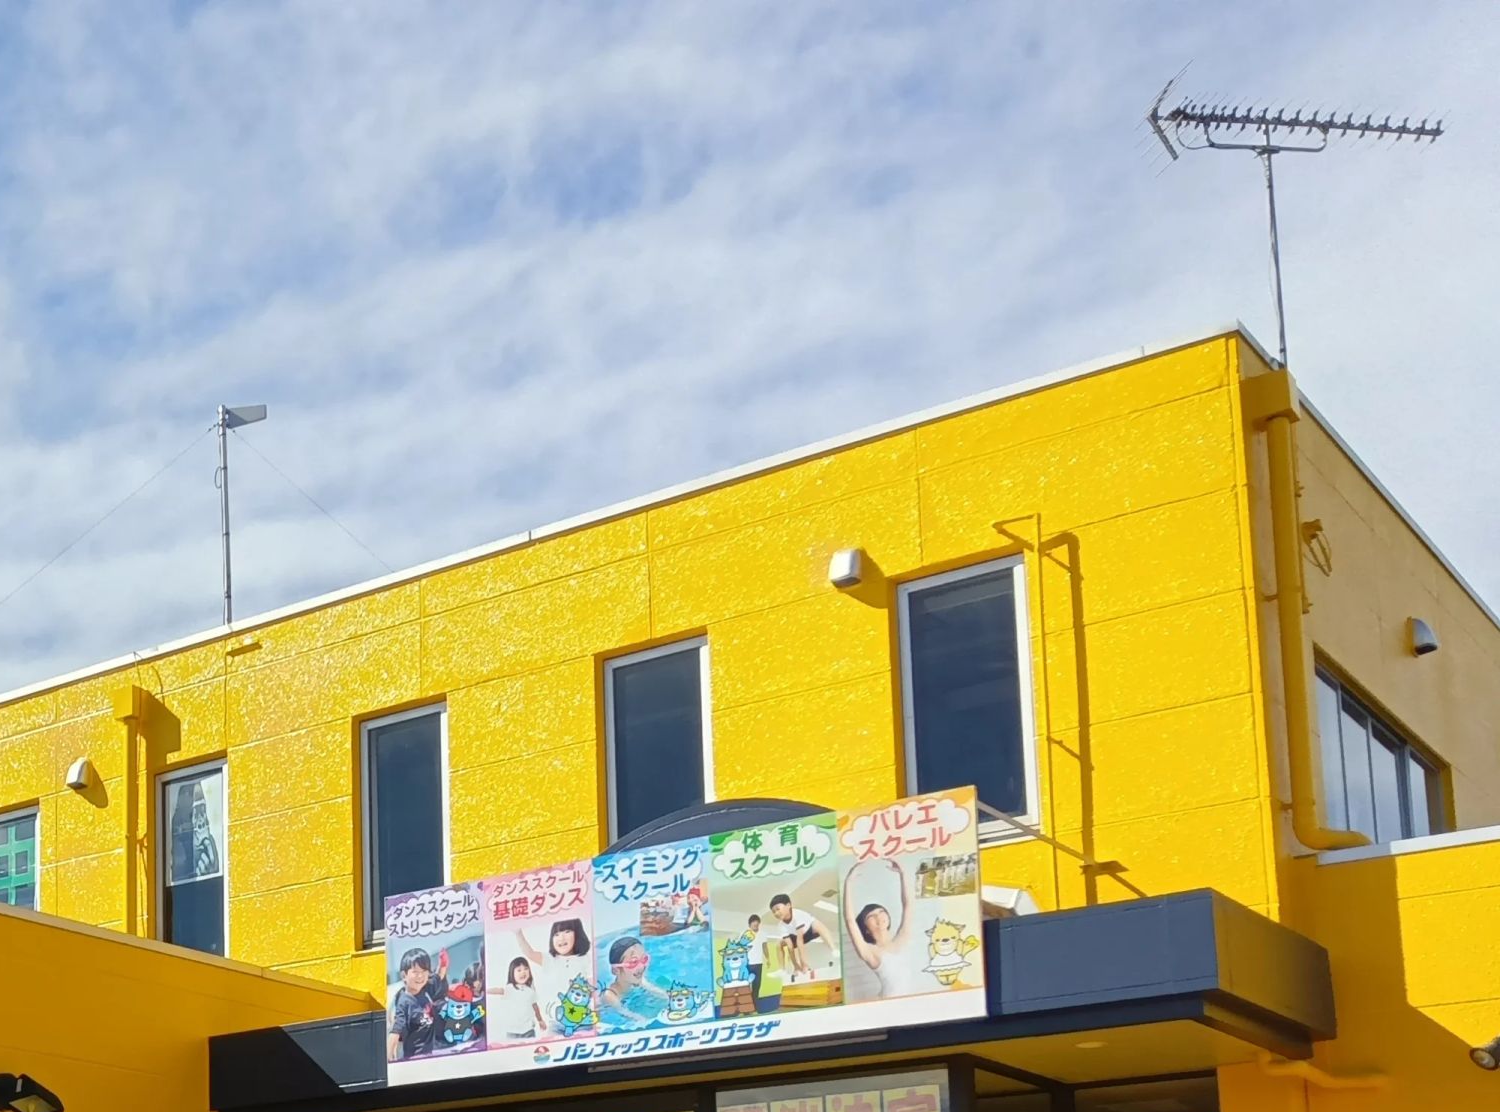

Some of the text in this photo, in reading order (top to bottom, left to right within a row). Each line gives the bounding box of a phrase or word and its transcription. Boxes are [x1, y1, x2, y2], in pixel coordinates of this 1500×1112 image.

[869, 803, 938, 835] バレエ
[856, 826, 953, 861] スクール
[602, 846, 701, 884] スイミング
[729, 845, 816, 879] スクール
[493, 869, 585, 899] ダンススクール
[612, 872, 691, 904] スクール
[393, 895, 475, 921] ダンススクール
[493, 887, 585, 921] 基礎ダンス
[389, 909, 480, 937] ストリートダンス
[553, 1020, 782, 1063] パシフィックスポーツプラザ
